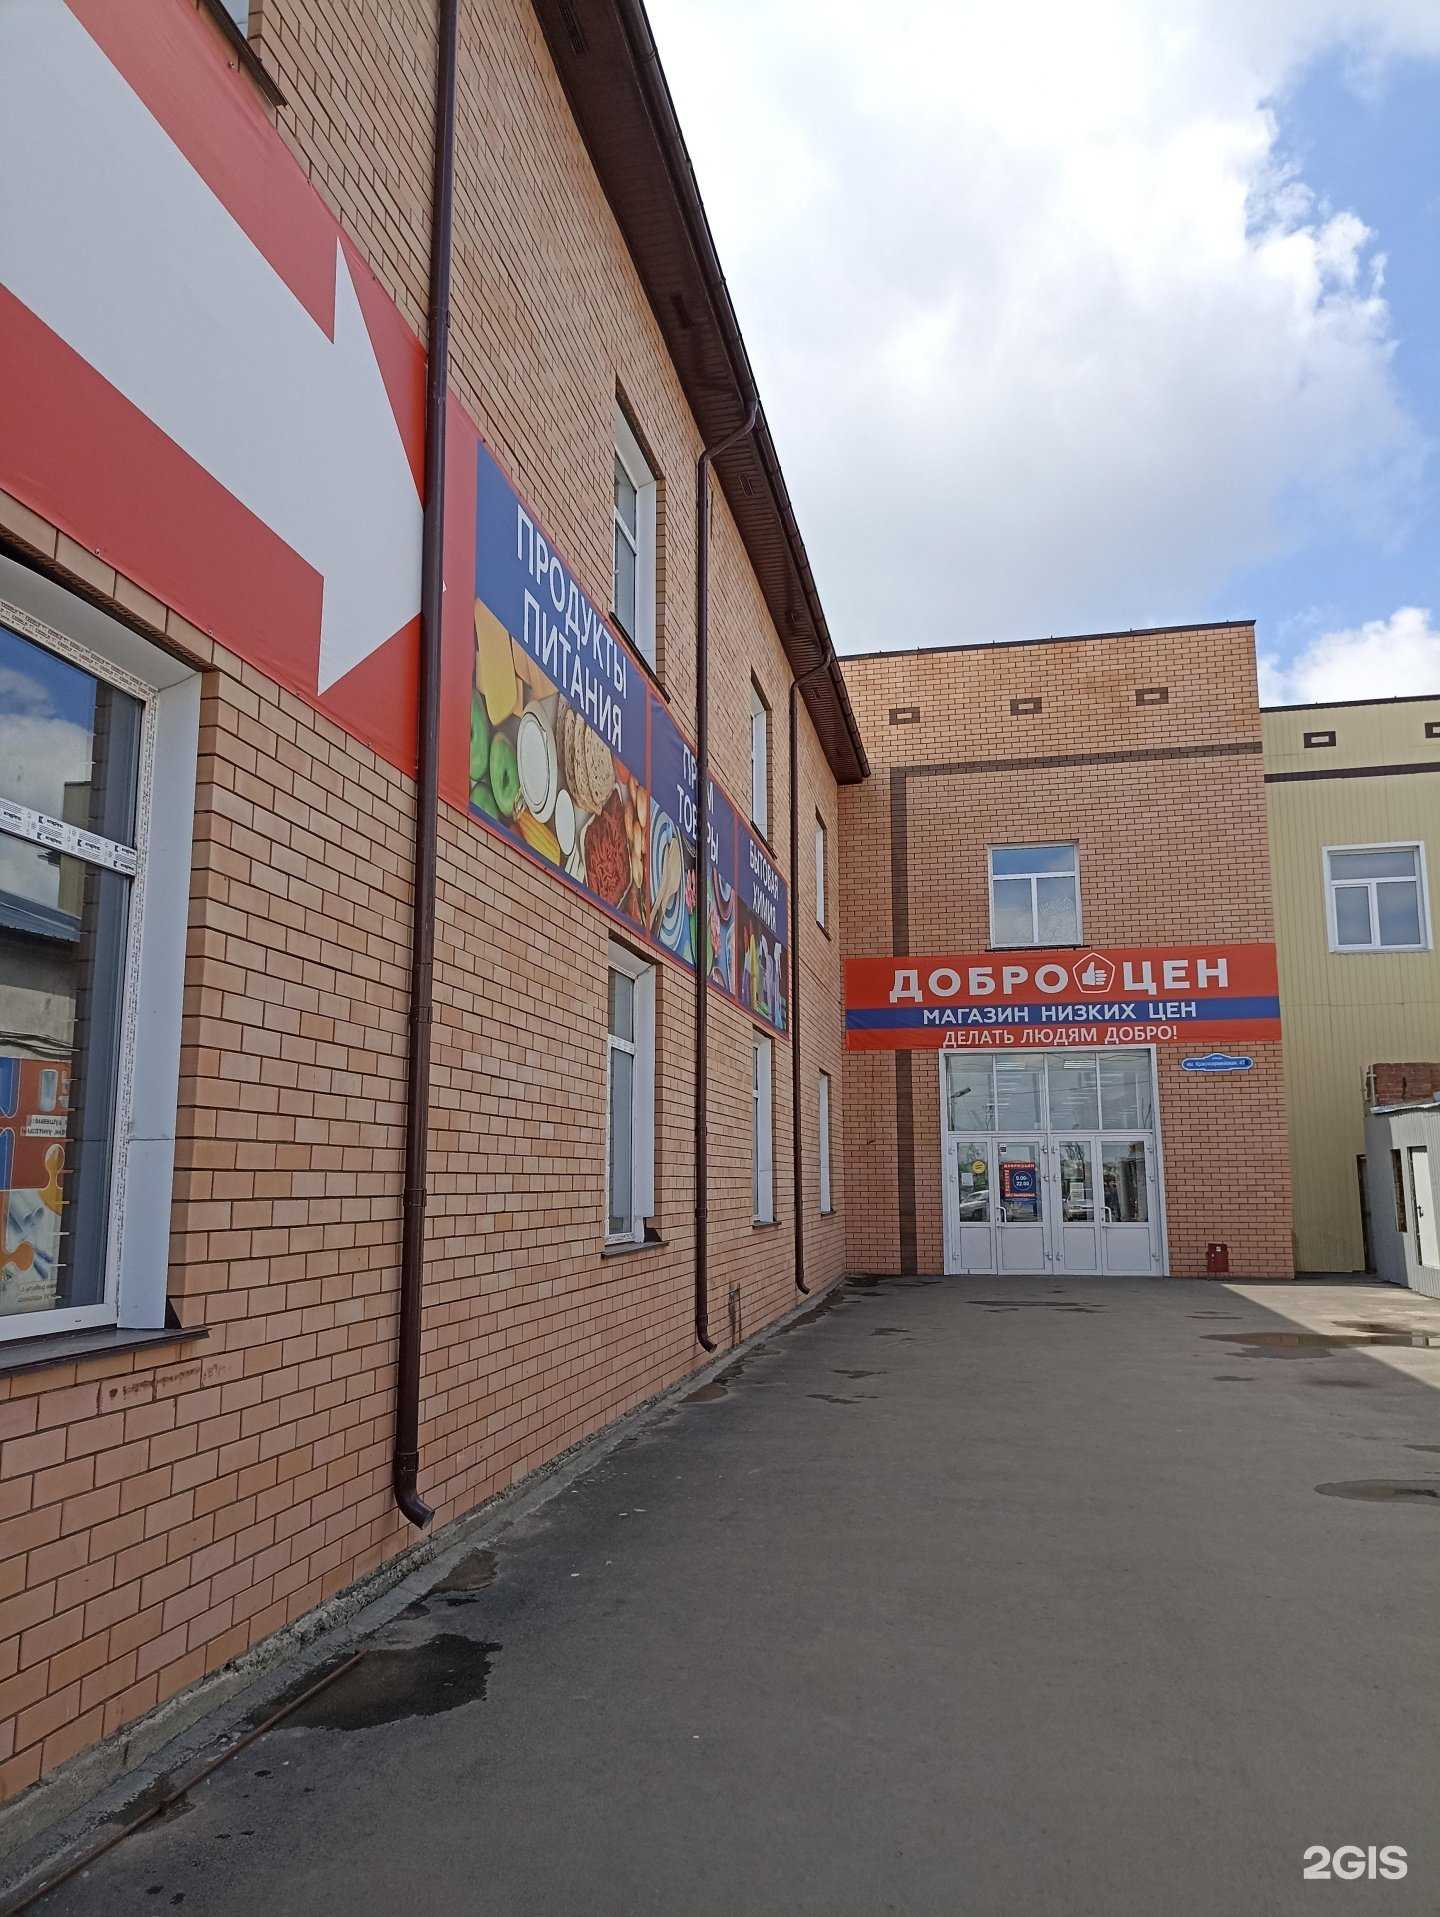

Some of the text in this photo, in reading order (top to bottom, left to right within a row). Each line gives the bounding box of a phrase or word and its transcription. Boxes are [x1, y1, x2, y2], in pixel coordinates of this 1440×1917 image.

[517, 503, 627, 699] ПРОДУКТЫ
[523, 588, 622, 753] ПИТАНИЯ
[683, 743, 714, 815] ПРМ
[676, 784, 719, 866] ТОВЫ
[749, 839, 779, 902] БЫТОВАЯ
[752, 881, 777, 934] ХИМИЯ
[889, 958, 1228, 1003] ДОБРО ЦЕН
[923, 1001, 1197, 1025] МАГАЗИН НИЗКИХ ЦЕН
[942, 1025, 1178, 1048] ДЕЛАТЬ ЛЮДЯМ ДОБРО!
